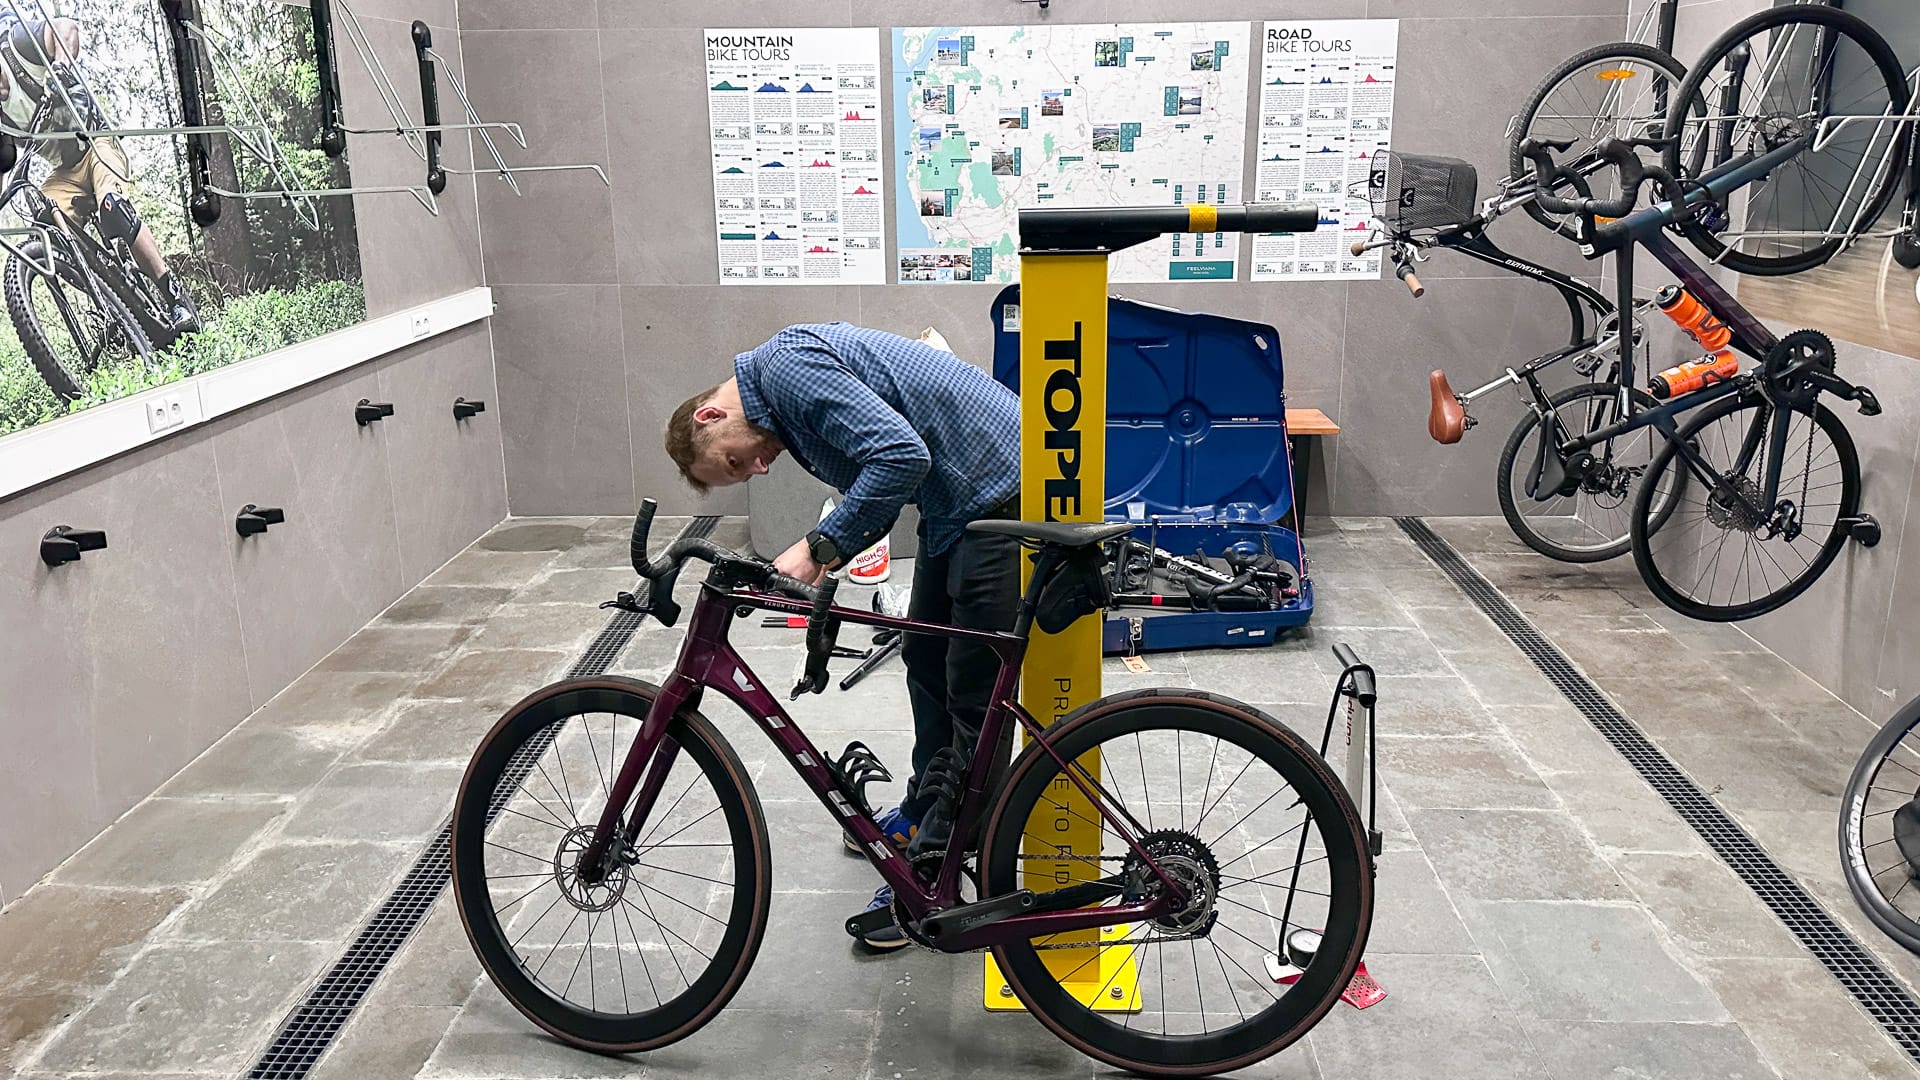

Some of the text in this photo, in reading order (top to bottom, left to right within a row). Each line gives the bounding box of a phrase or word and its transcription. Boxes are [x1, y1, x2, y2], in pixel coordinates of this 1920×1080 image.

[706, 35, 794, 48] MOUNTAIN
[1267, 28, 1313, 40] ROAD
[1267, 39, 1352, 54] BIKE TOURS
[707, 48, 790, 61] BIKE TOURS
[1044, 321, 1082, 522] TOPE
[1055, 801, 1069, 831] TO
[1055, 845, 1072, 885] RID
